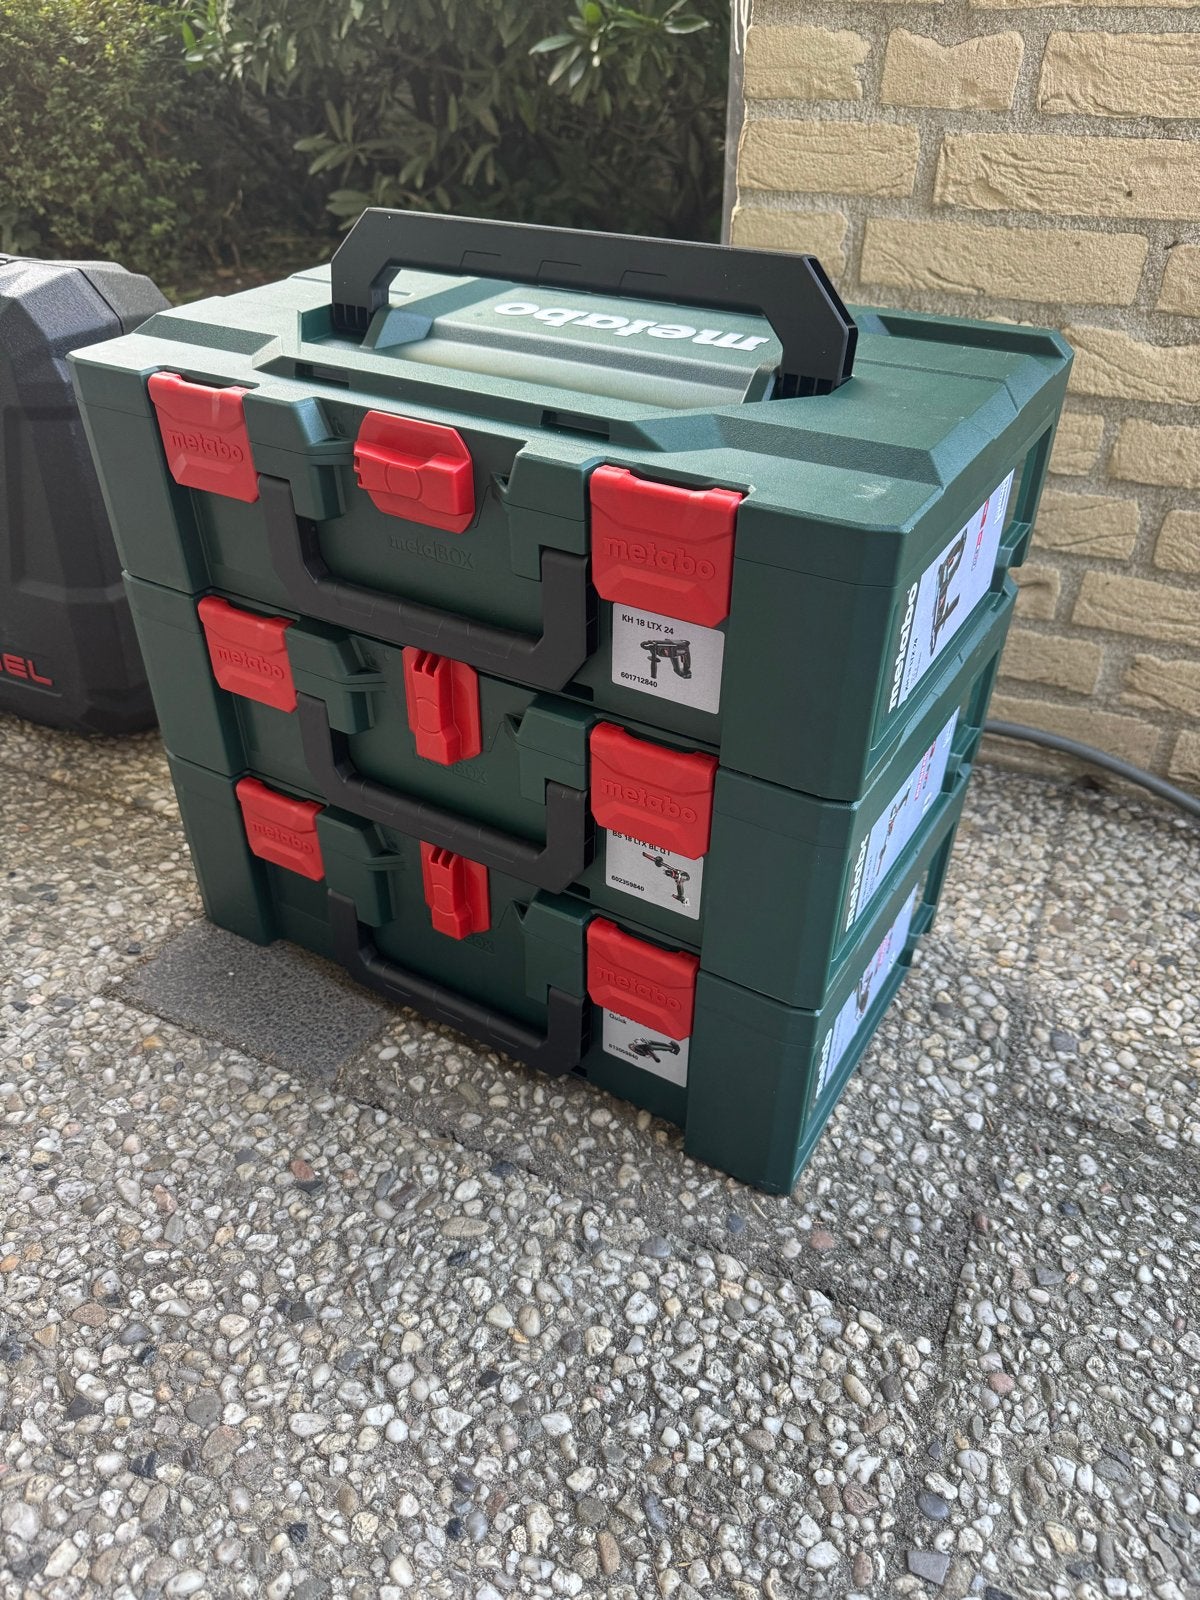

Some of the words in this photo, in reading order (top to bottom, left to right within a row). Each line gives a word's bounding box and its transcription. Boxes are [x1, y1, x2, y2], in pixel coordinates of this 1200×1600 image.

[494, 302, 770, 352] metabo
[166, 428, 245, 463] metabo
[389, 534, 475, 570] metaBOX
[603, 537, 716, 581] metabo
[621, 613, 634, 624] KH
[636, 618, 646, 627] 18
[647, 620, 663, 632] LTX
[664, 626, 675, 635] 24
[214, 644, 285, 680] metabo
[887, 581, 919, 714] metabo
[0, 651, 53, 687] EL
[620, 671, 658, 688] 601712840
[600, 778, 698, 824] metabo
[251, 822, 315, 855] metabo
[612, 829, 623, 839] BS
[634, 838, 648, 848] LTX
[648, 843, 659, 852] BL
[611, 874, 645, 892] 602359840
[596, 966, 682, 1010] metabo
[608, 1012, 627, 1025] Quick
